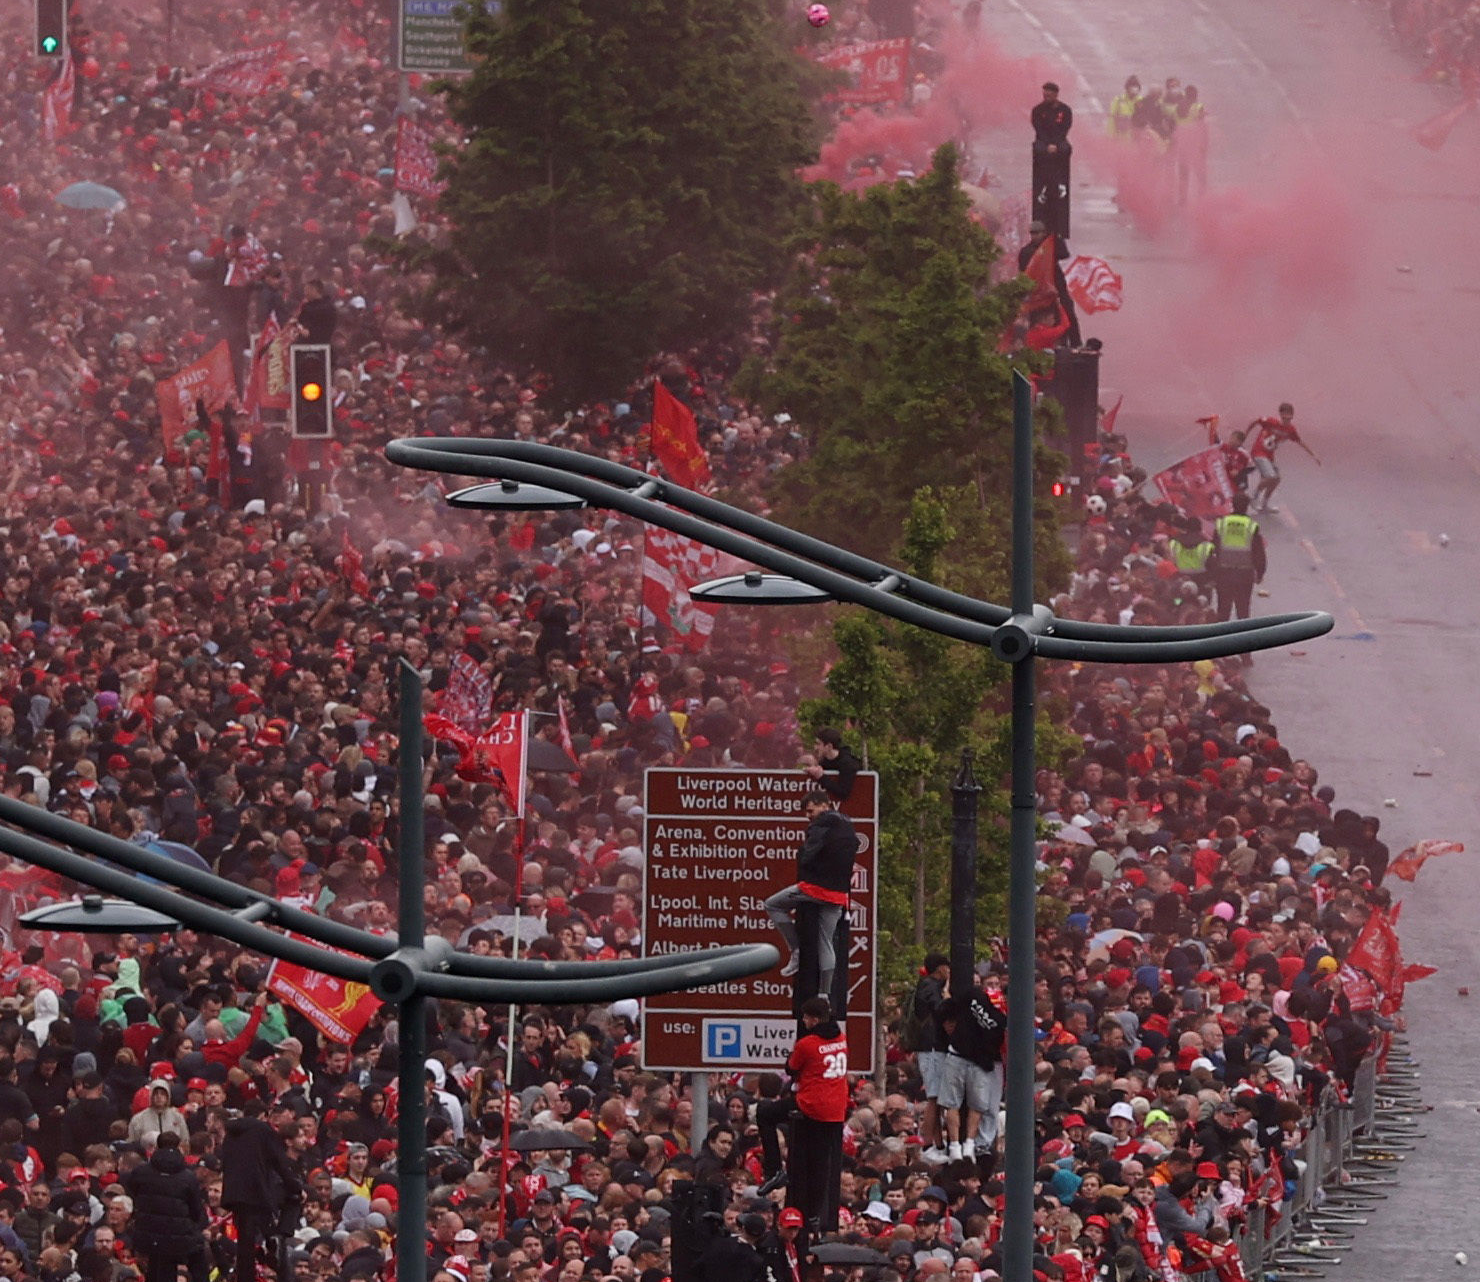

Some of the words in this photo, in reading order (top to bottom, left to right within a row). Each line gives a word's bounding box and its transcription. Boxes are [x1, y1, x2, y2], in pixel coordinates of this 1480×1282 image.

[677, 777, 752, 794] Liverpool
[757, 777, 826, 794] Waterfro
[680, 796, 727, 810] World
[734, 796, 802, 814] Heritage
[655, 825, 707, 841] Arena,
[714, 826, 806, 841] Convention
[652, 845, 664, 858] &
[669, 844, 748, 859] Exhibition
[753, 845, 799, 859] Centr
[651, 864, 688, 879] Tate
[694, 865, 769, 882] Liverpool
[708, 896, 732, 910] Int.
[658, 914, 728, 929] Maritime
[733, 915, 776, 930] Muse
[651, 941, 702, 957] Albert
[752, 981, 794, 997] Story
[663, 1021, 696, 1034] use:
[714, 1026, 737, 1056] P
[754, 1025, 796, 1039] Liver
[823, 1051, 848, 1079] 20
